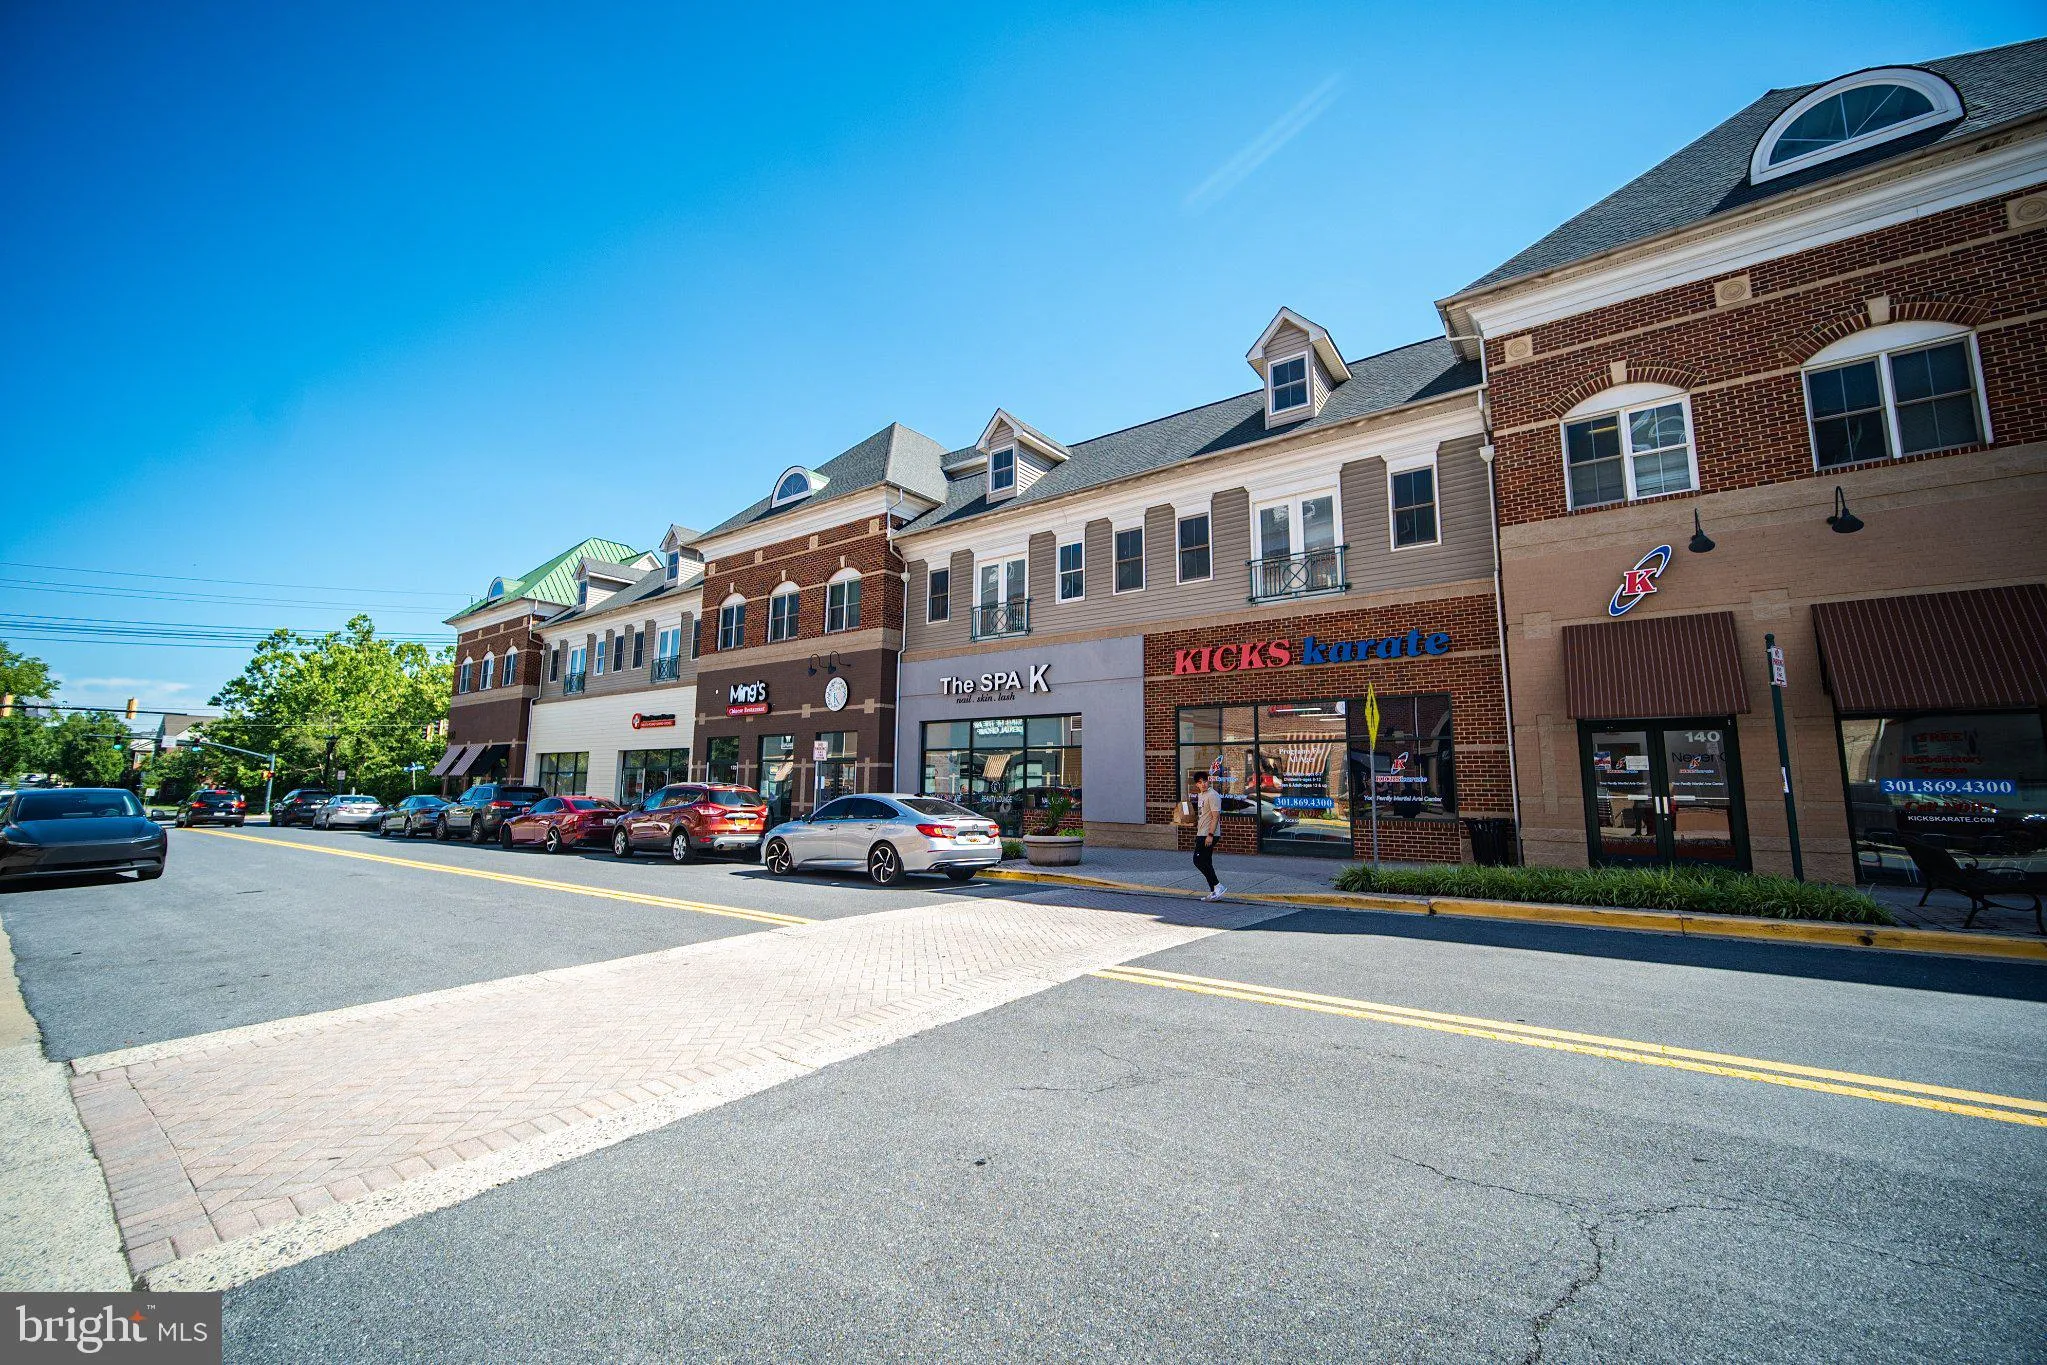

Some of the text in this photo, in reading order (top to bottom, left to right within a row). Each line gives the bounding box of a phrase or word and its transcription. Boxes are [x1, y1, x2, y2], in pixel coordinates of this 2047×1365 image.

[1623, 568, 1657, 595] K
[1172, 628, 1449, 675] KICKS karate
[940, 664, 1050, 695] The SPA K
[730, 680, 766, 703] Ming's
[956, 692, 1015, 703] nail skin lash
[1685, 731, 1720, 742] 140
[1394, 760, 1405, 769] K
[1902, 755, 1984, 765] Introductory
[1884, 780, 2012, 793] 301.869.4300
[1276, 798, 1332, 807] 301.869.4300
[1907, 815, 1995, 823] KICKSKARATE.COM
